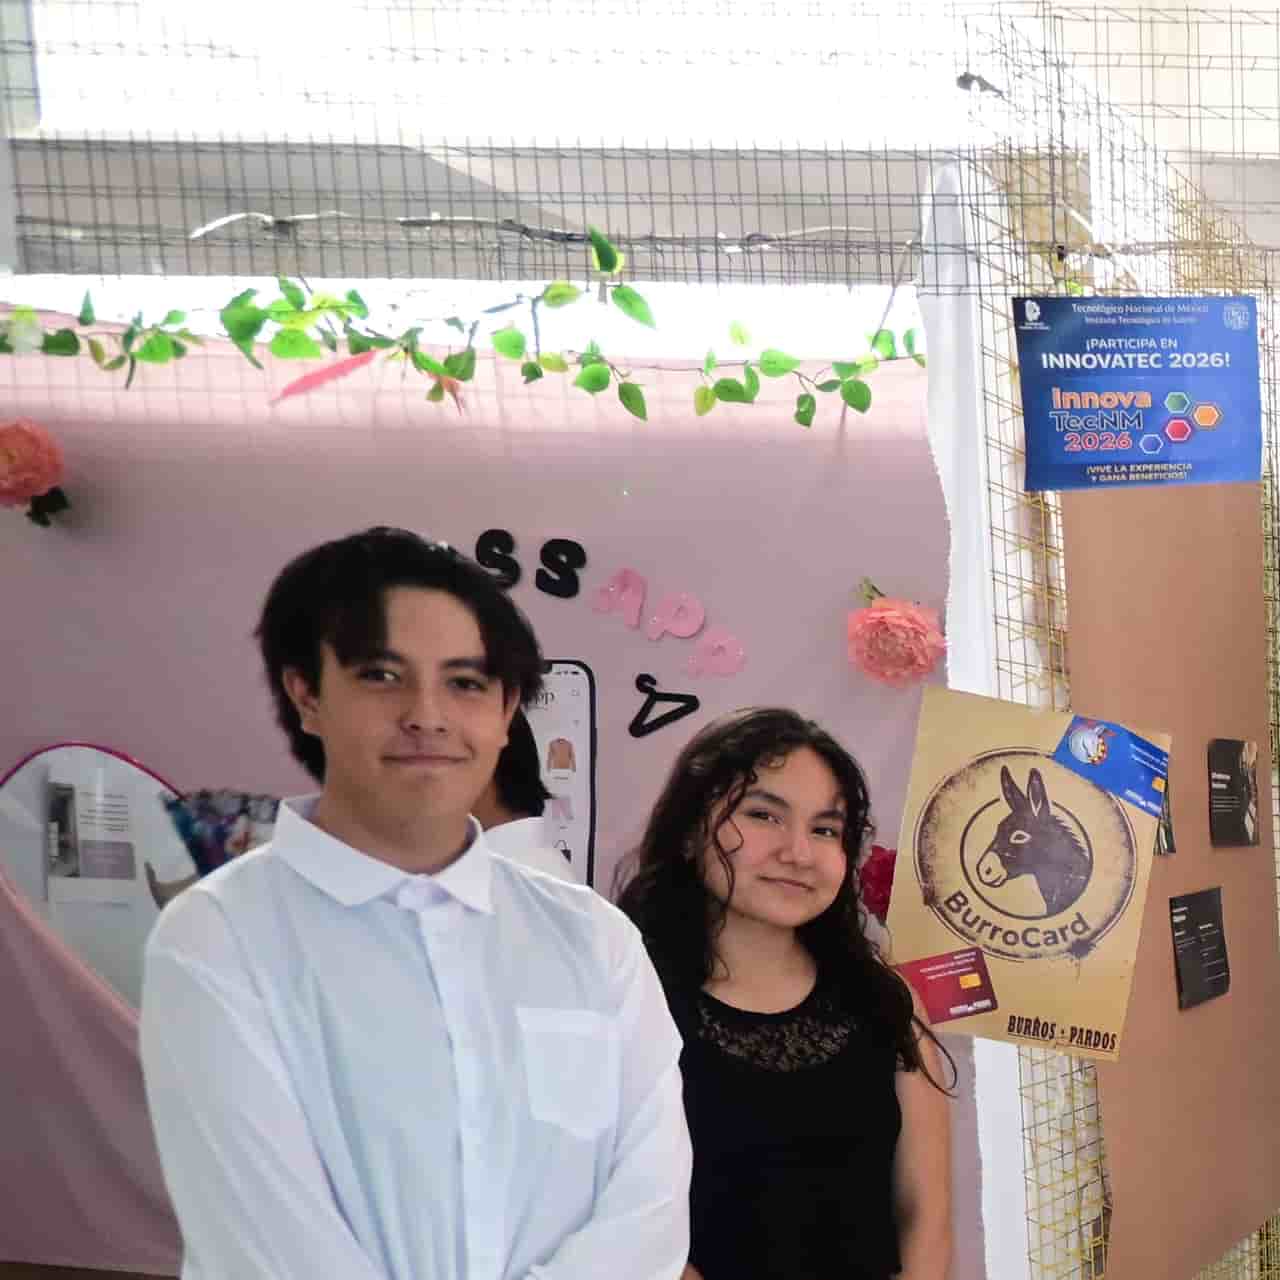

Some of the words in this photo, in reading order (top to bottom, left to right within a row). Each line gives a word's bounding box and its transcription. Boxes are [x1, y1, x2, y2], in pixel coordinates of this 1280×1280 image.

[1086, 339, 1157, 351] ¡PARTICIPA
[1161, 338, 1177, 349] EN
[1041, 353, 1162, 369] INNOVATEC
[1169, 352, 1231, 368] 2026!
[1051, 386, 1152, 409] Innova
[1049, 409, 1144, 432] TecNM
[1064, 432, 1133, 452] 2026
[1114, 464, 1128, 473] LA
[1130, 463, 1192, 473] EXPERIENCIA
[944, 890, 1090, 947] BurroCard
[1008, 1014, 1056, 1040] BURROS
[1070, 1026, 1117, 1050] PARDOS
